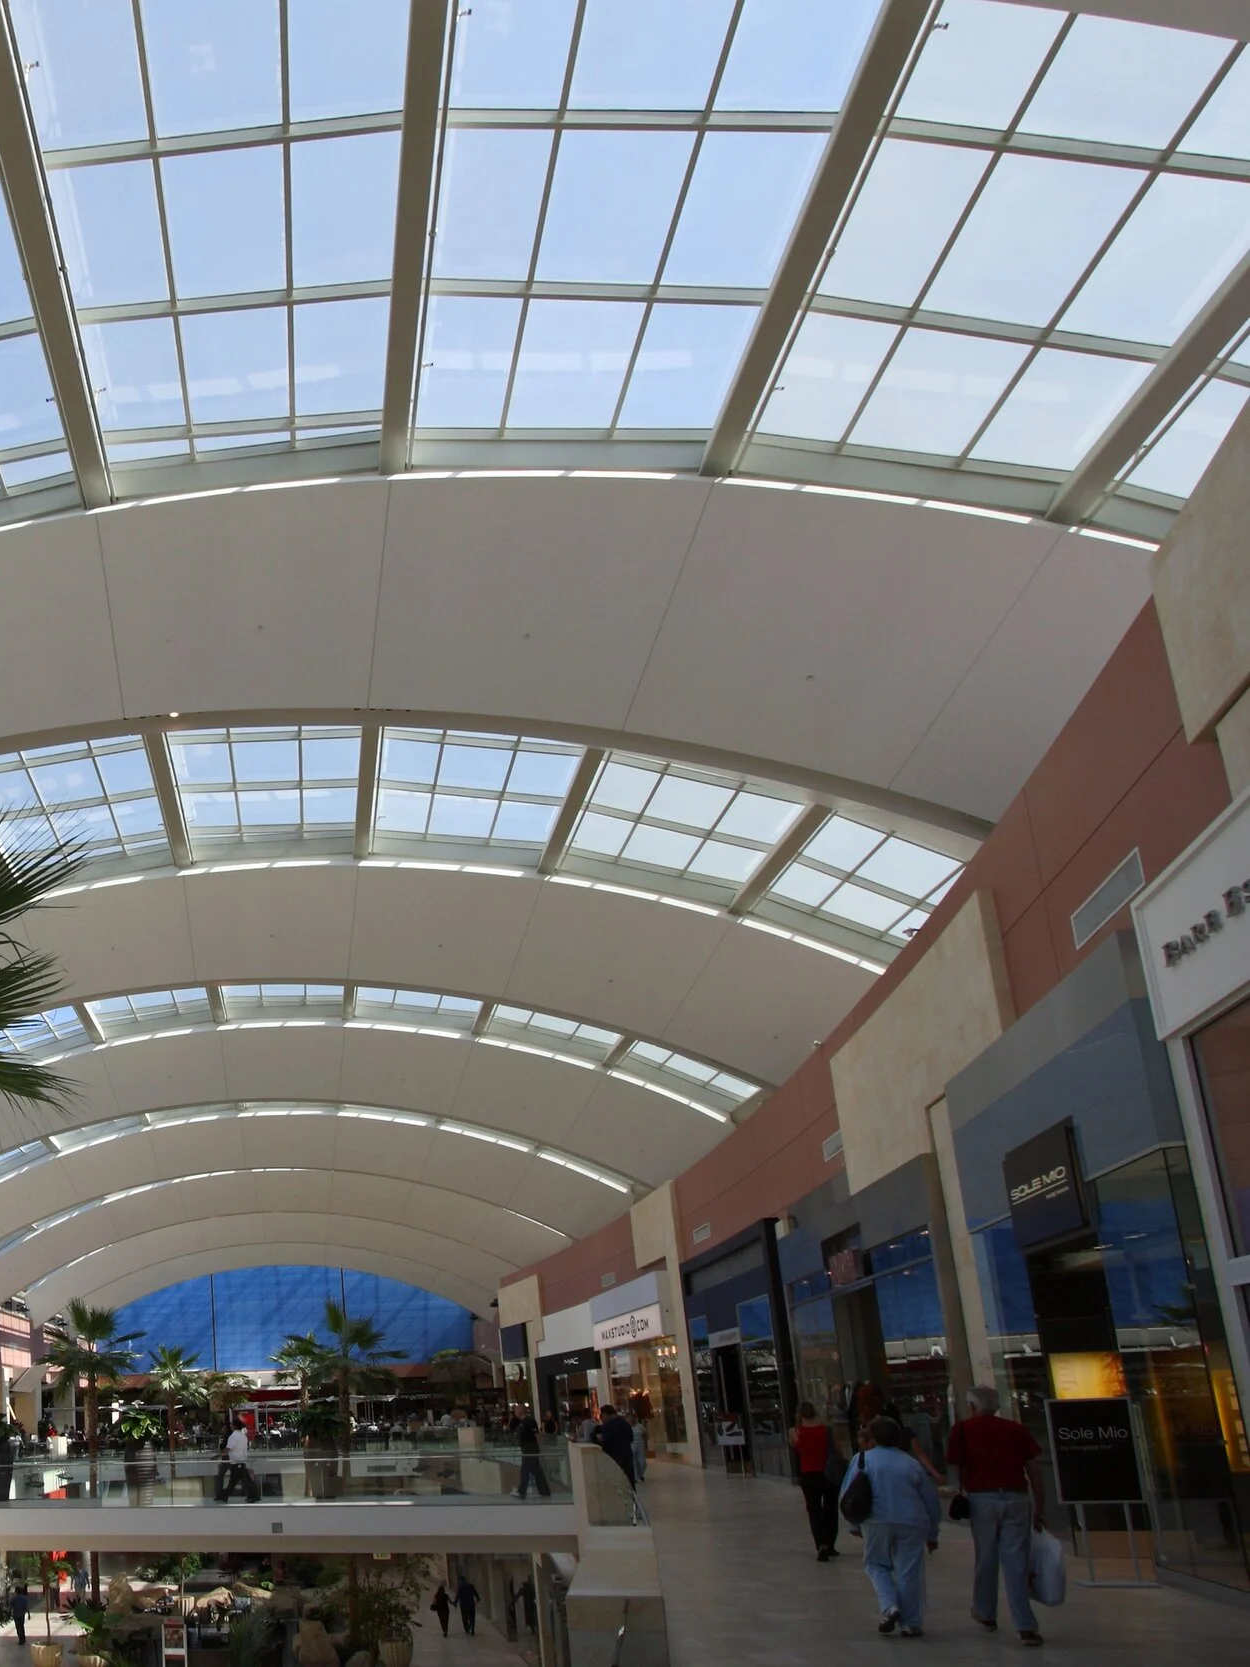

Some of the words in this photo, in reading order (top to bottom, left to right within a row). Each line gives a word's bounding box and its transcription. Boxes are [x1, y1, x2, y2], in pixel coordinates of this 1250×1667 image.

[1161, 909, 1223, 968] BARE
[1011, 1177, 1042, 1201] SOLE
[1041, 1166, 1067, 1186] MIO
[1058, 1426, 1094, 1440] Sole
[1098, 1426, 1128, 1440] Mio
